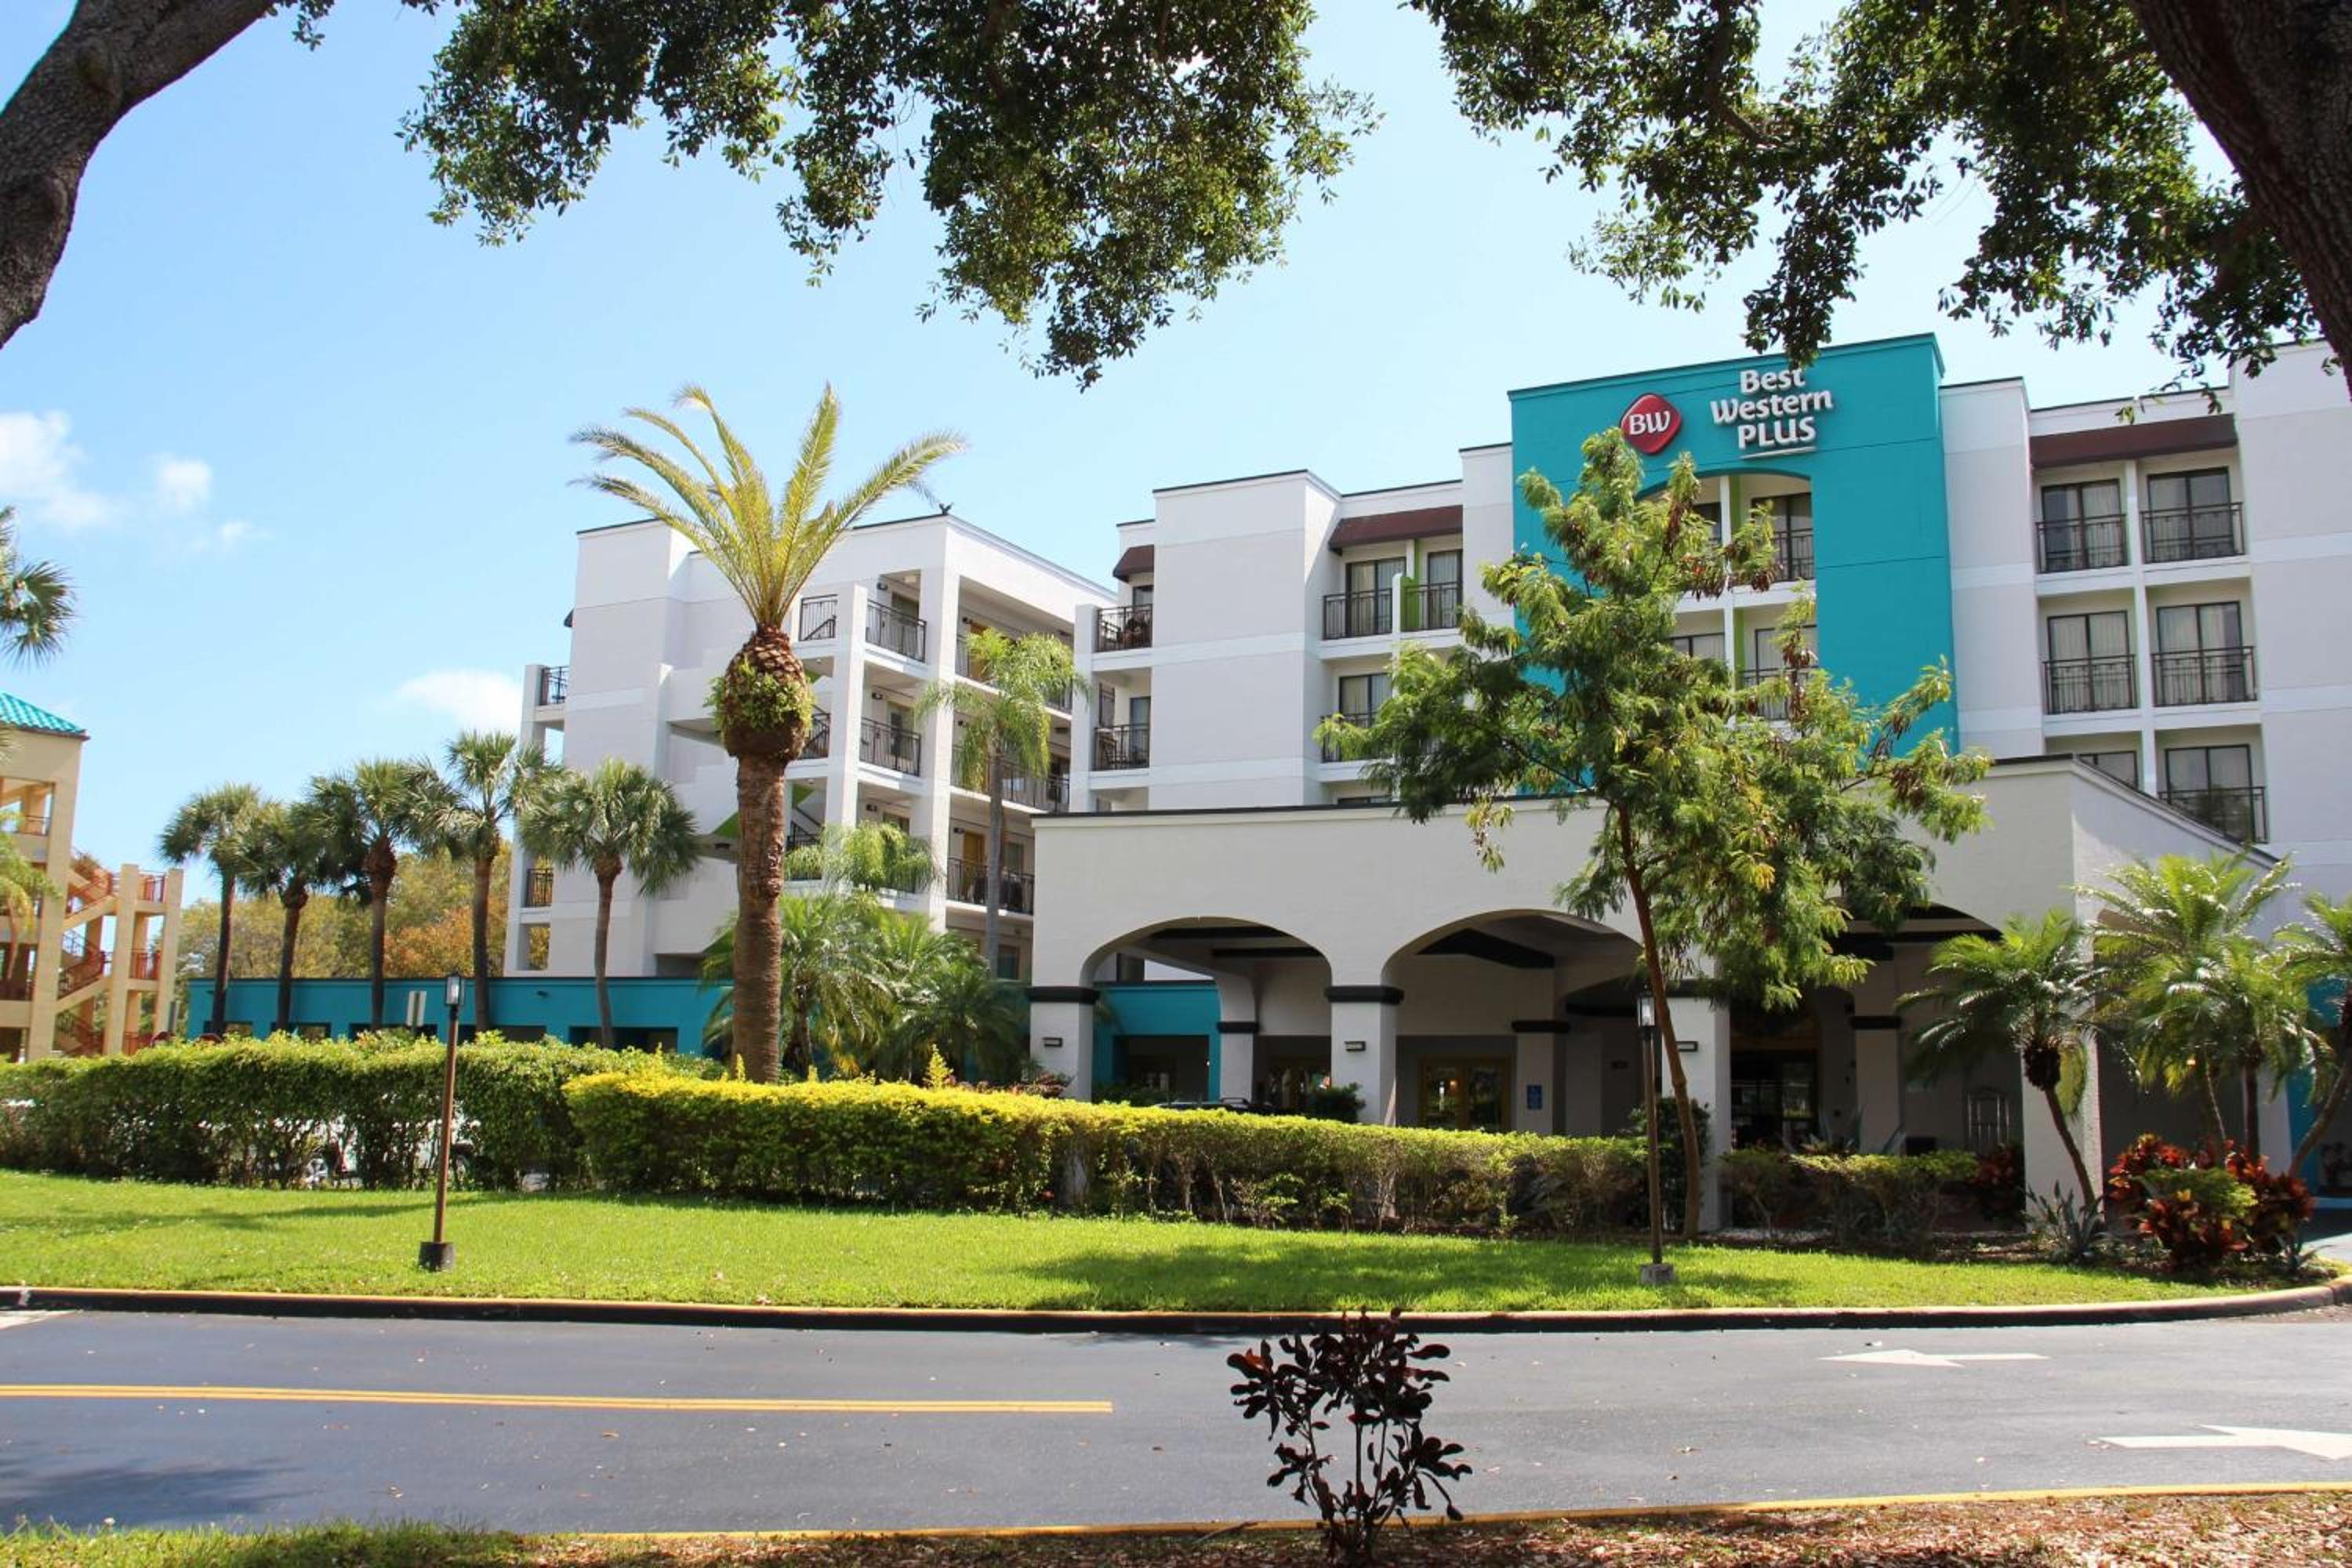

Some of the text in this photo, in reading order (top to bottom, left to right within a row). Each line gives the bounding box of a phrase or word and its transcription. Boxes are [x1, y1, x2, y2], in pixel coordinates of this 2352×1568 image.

[1740, 368, 1806, 394] Best
[1710, 390, 1833, 424] Western
[1628, 410, 1671, 436] BW
[1737, 416, 1817, 449] PLUS
